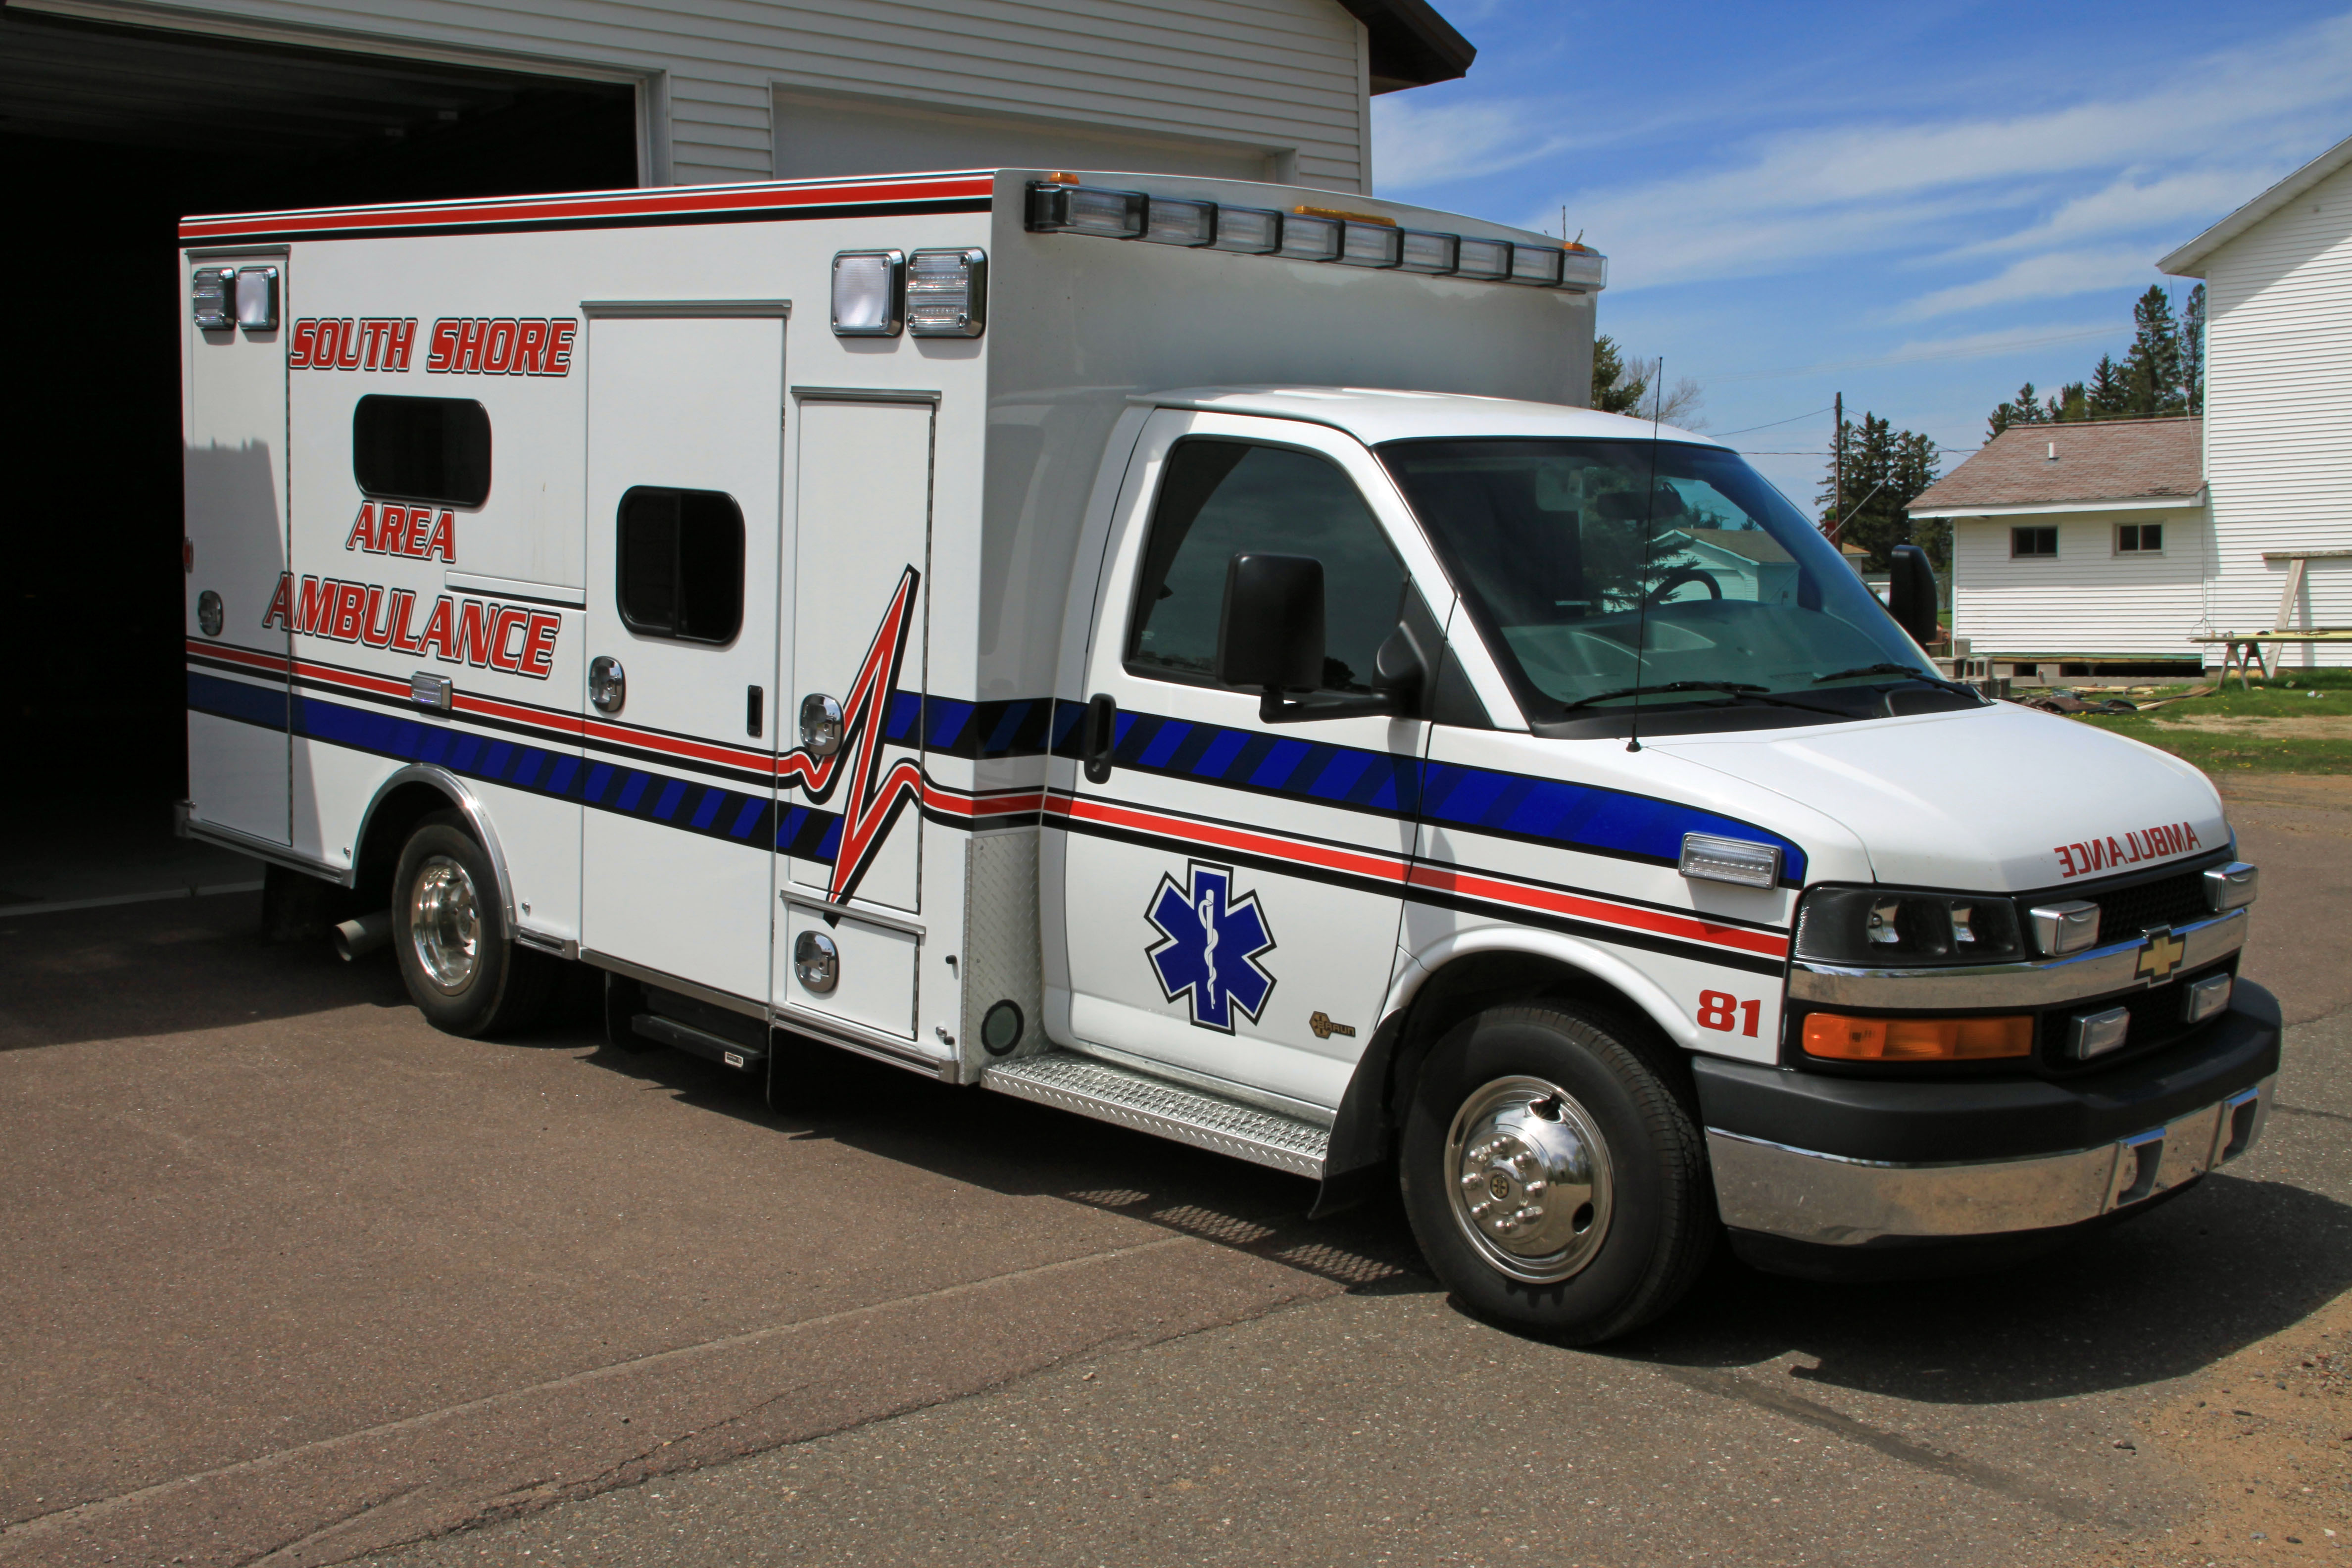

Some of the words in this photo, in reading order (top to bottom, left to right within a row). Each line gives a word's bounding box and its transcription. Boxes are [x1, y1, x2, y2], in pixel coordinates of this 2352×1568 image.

[290, 317, 418, 372] SOUTH
[427, 317, 578, 377] SHORE
[345, 500, 456, 564] AREA
[262, 572, 561, 681] AMBULANCE
[1697, 989, 1761, 1038] 81
